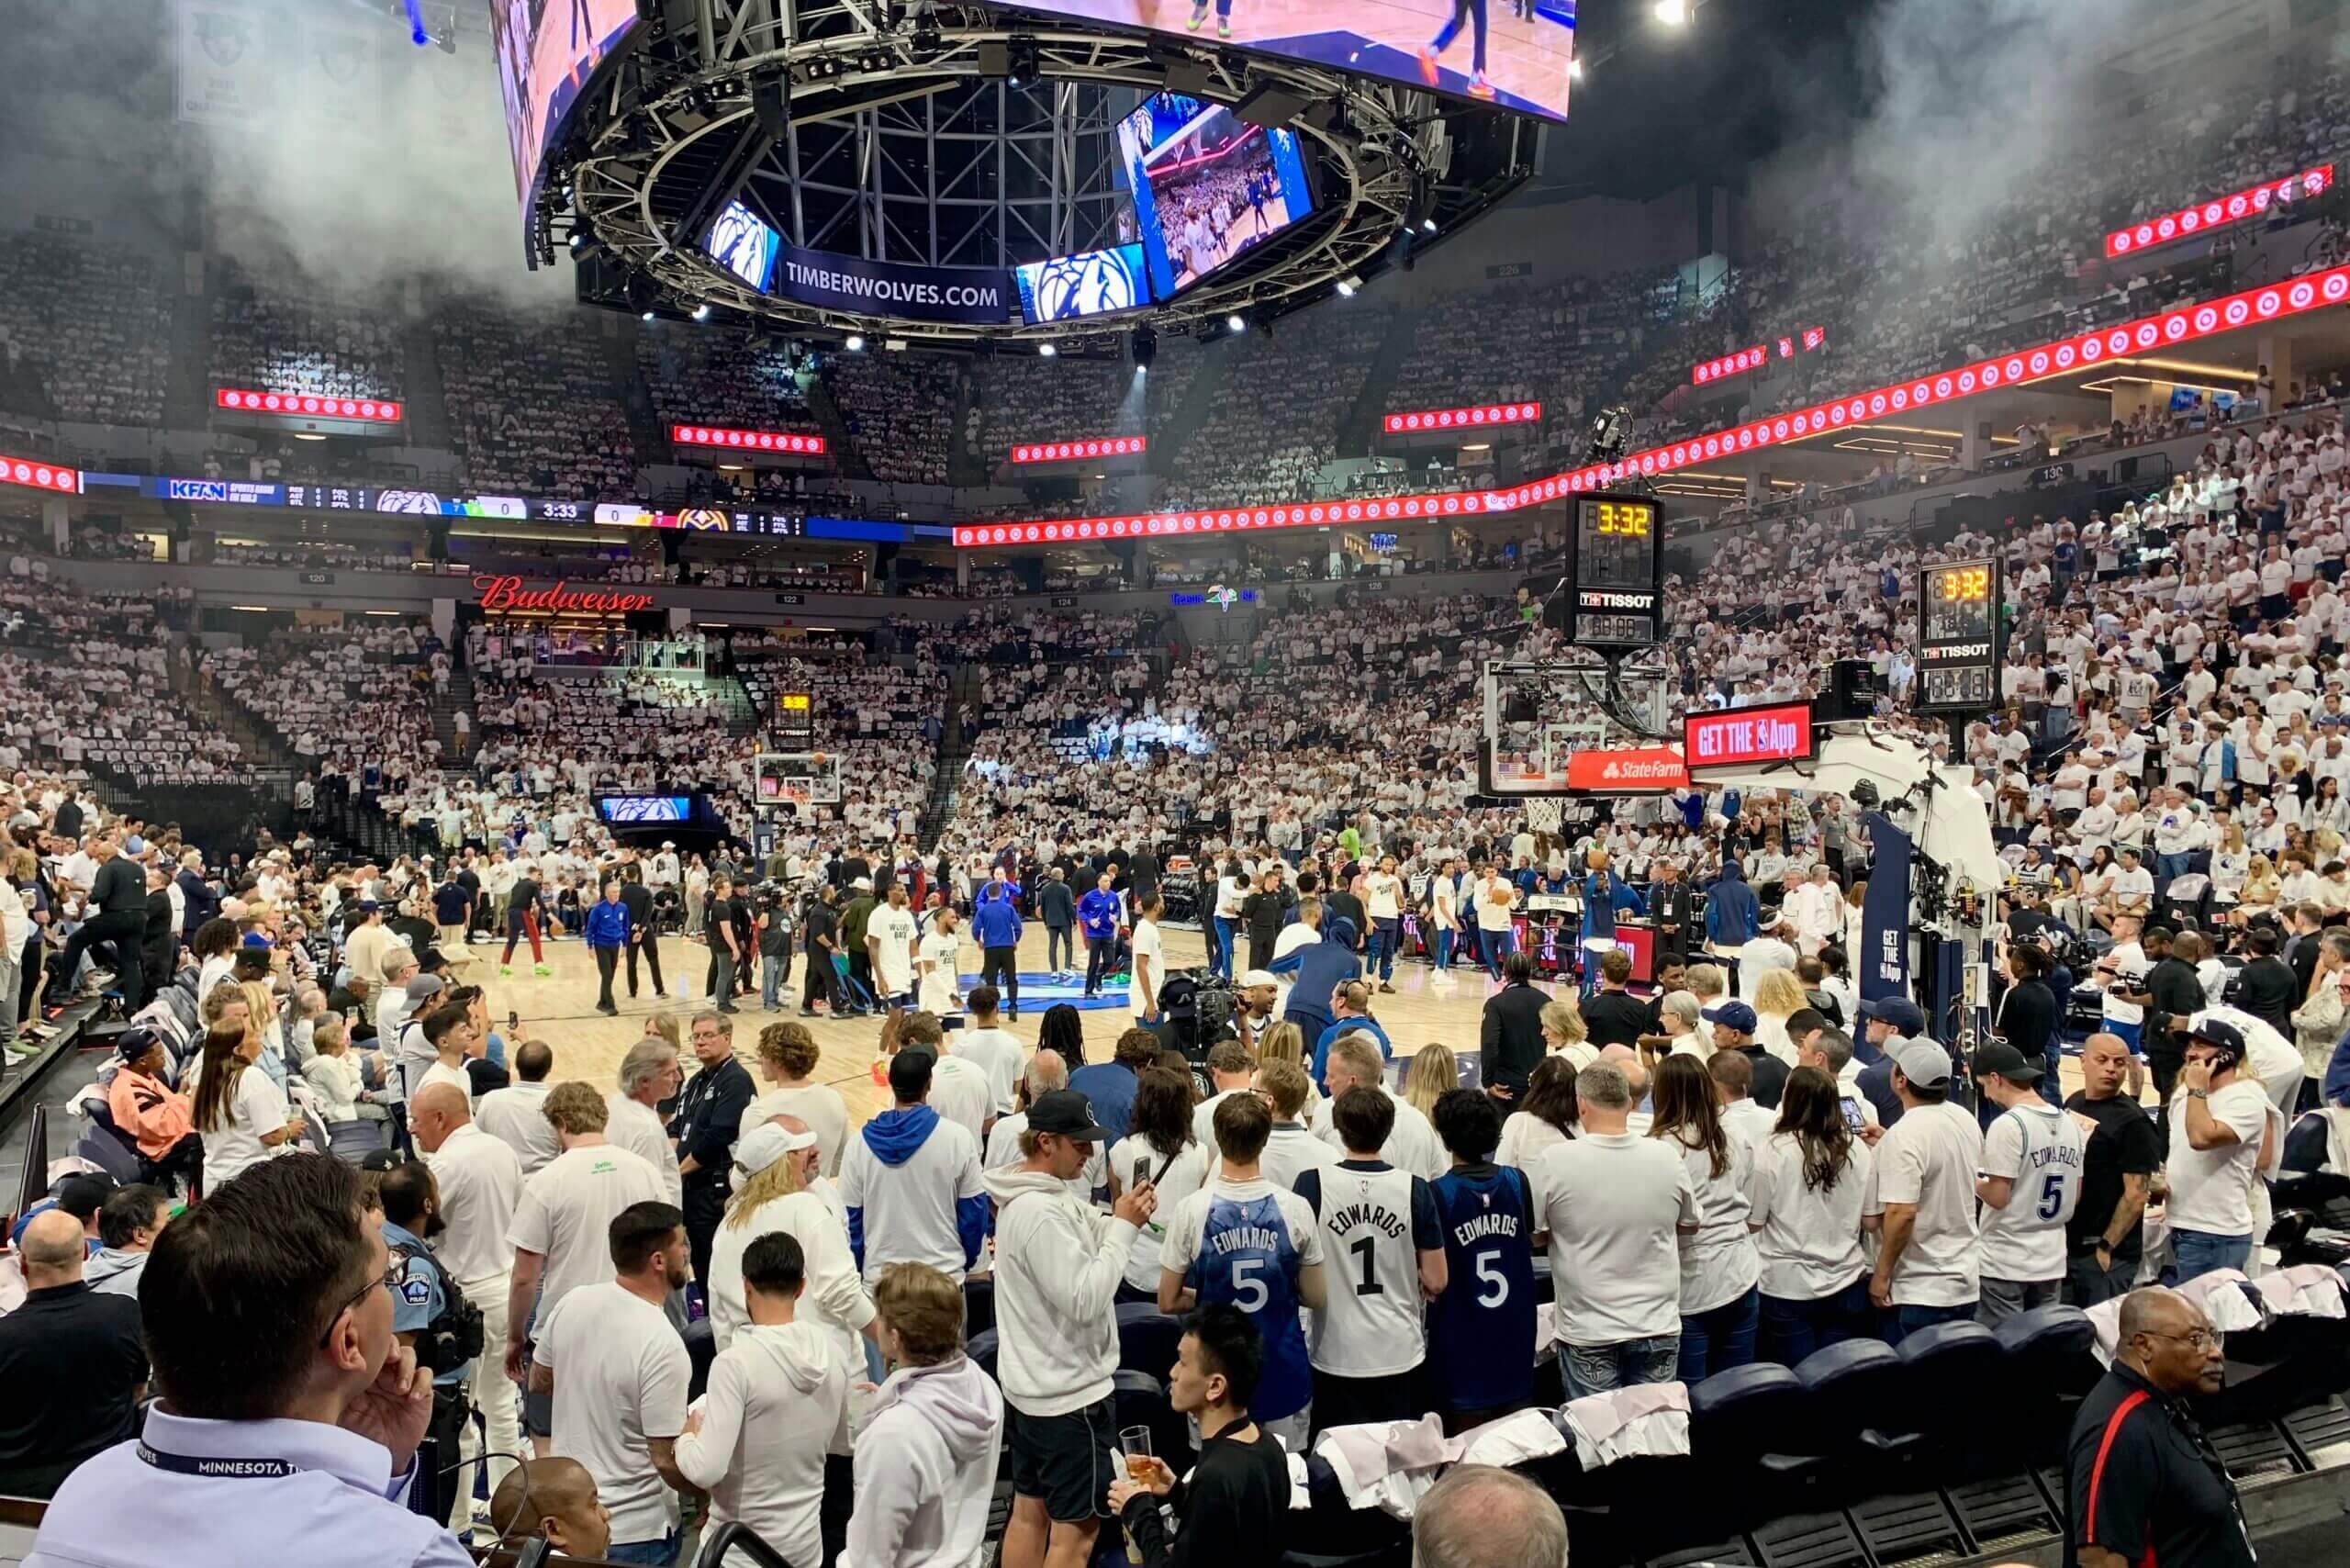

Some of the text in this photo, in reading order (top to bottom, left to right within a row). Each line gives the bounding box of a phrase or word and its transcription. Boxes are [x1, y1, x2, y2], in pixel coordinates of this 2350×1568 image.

[786, 262, 998, 308] TIMBERWOLVES.COM
[171, 480, 227, 501] KFAN
[501, 503, 509, 515] 0
[543, 503, 577, 518] 3:33
[611, 510, 619, 521] 0
[1599, 504, 1649, 534] 3:32
[308, 574, 326, 583] 120
[1944, 570, 1986, 601] 3:32
[472, 576, 654, 610] Budweiser
[1058, 598, 1072, 607] 124
[1602, 594, 1654, 609] TISSOT
[1940, 644, 1990, 658] TISSOT
[1698, 718, 1797, 756] GET THE App
[1883, 929, 1898, 946] GET
[1883, 946, 1898, 963] THE
[1886, 964, 1901, 982] App
[2030, 1146, 2079, 1169] EDWARDS
[2036, 1174, 2065, 1222] 5
[1327, 1204, 1405, 1239] EDWARDS
[1454, 1214, 1518, 1248] EDWARDS
[1211, 1227, 1279, 1254] EDWARDS
[1351, 1237, 1383, 1296] 1
[1232, 1259, 1270, 1314] 5
[1476, 1249, 1510, 1309] 5
[199, 1462, 284, 1474] MINNESOTA
